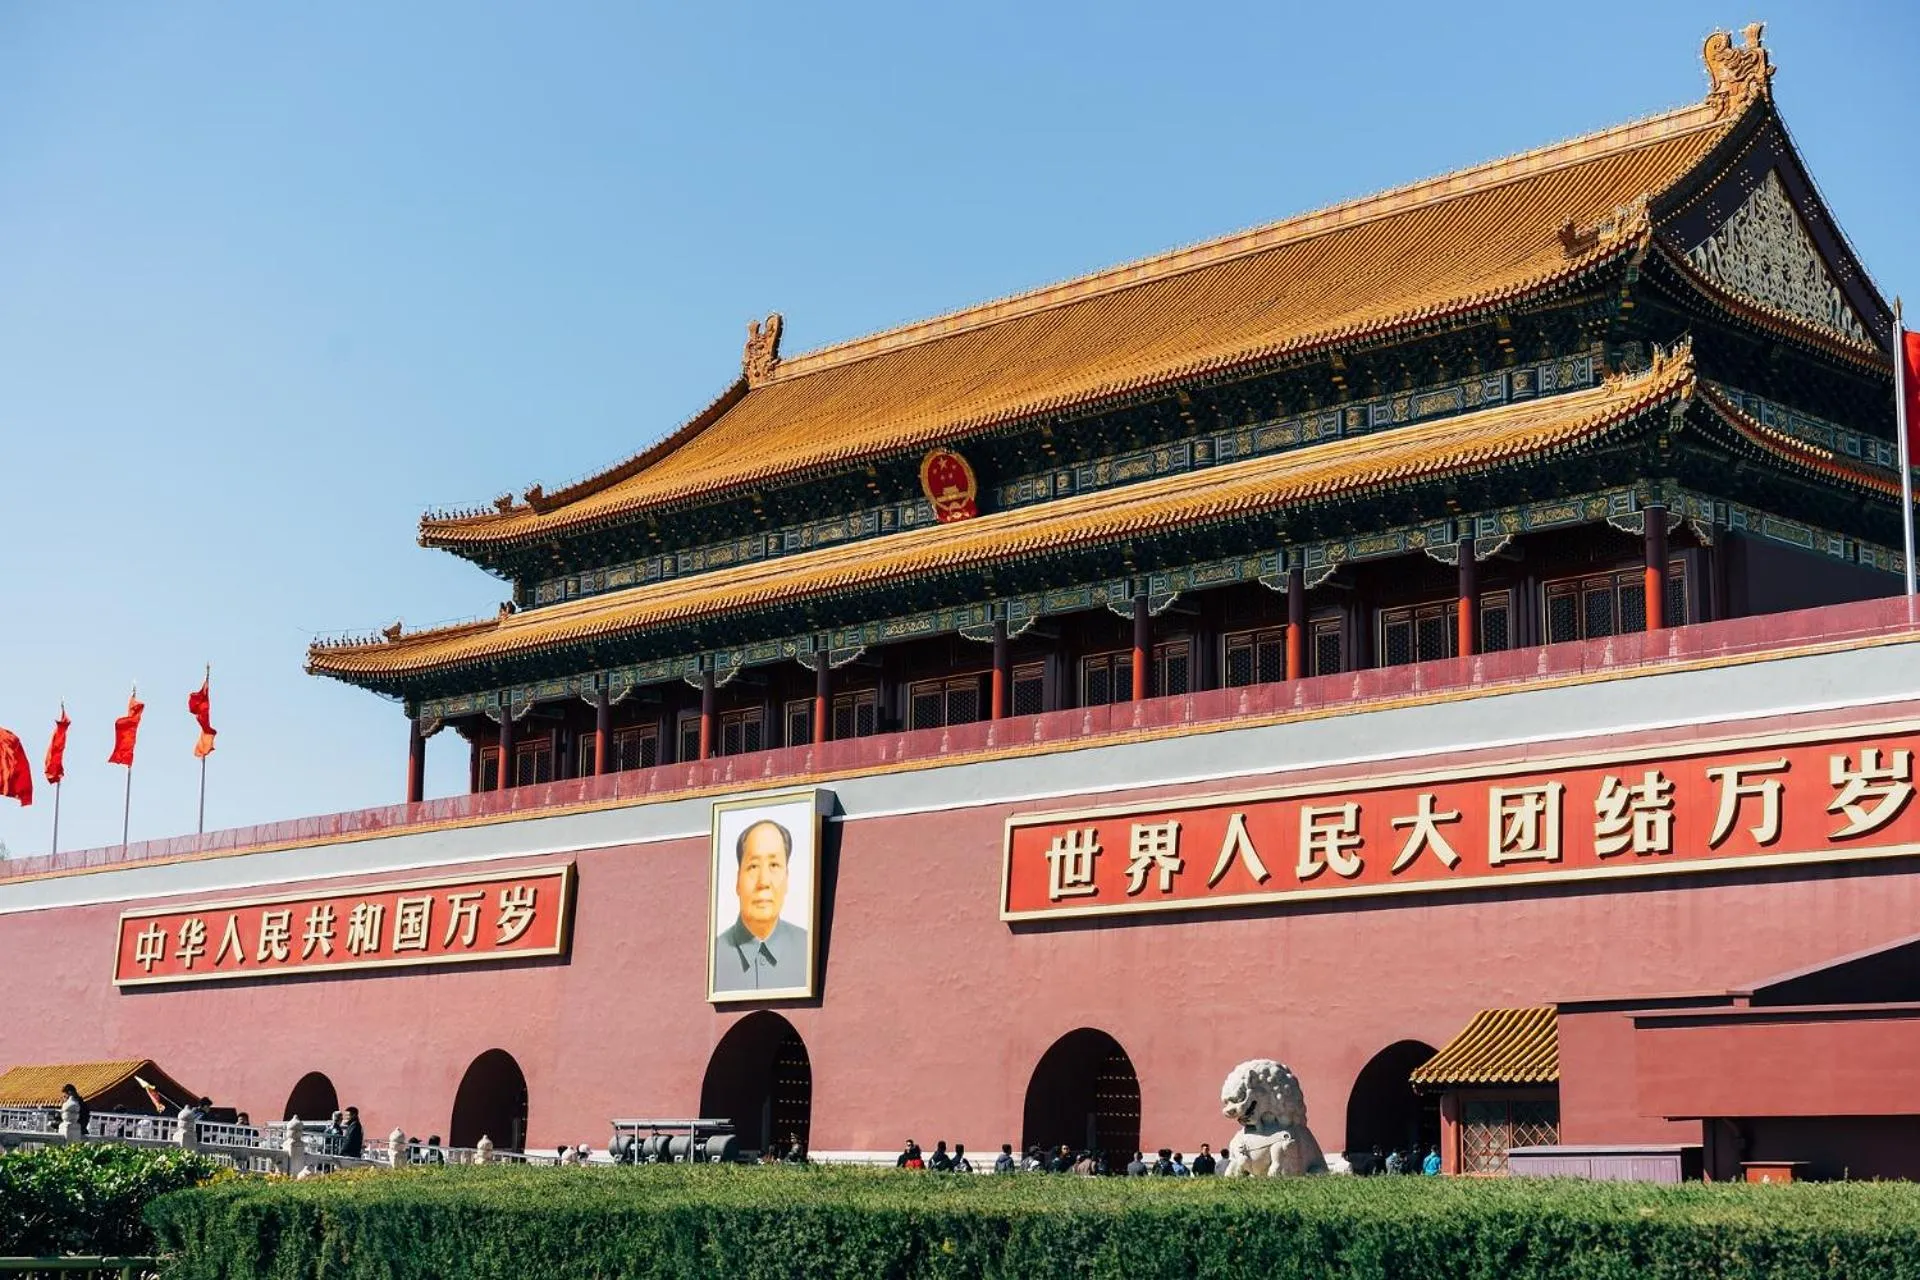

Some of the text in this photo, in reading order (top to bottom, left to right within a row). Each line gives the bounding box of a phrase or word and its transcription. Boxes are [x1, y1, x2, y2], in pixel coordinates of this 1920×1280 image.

[1045, 748, 1915, 901] 世界人民大团结万岁
[135, 885, 537, 972] 中华人民共和国万岁
